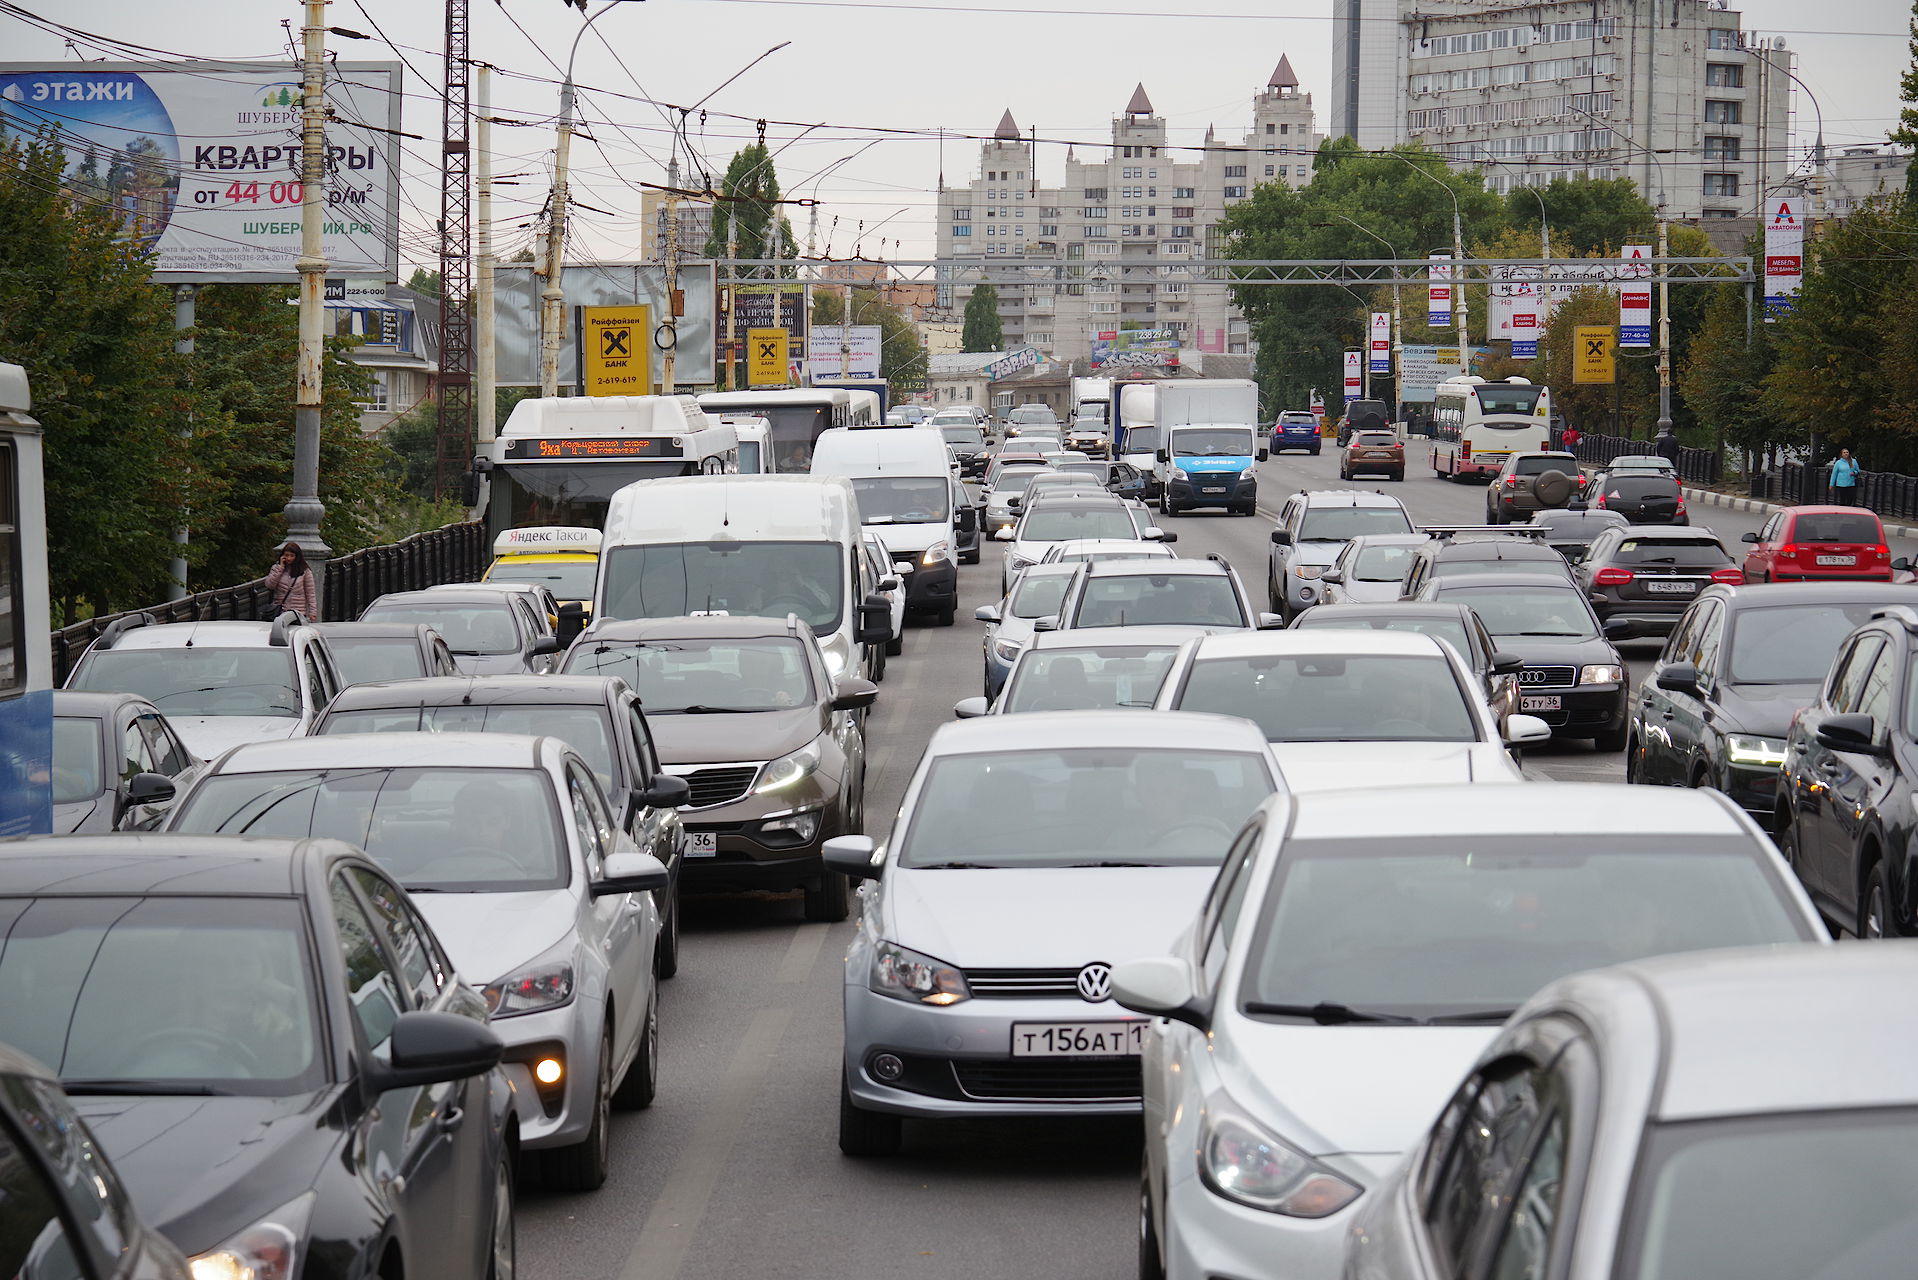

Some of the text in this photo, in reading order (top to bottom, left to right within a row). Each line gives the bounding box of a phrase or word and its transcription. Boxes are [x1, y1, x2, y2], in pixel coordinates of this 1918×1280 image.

[32, 82, 133, 101] этажи
[194, 145, 374, 170] КВАРТРЫ
[194, 190, 219, 203] от
[225, 181, 260, 203] 44
[591, 318, 640, 326] Райффайзен
[1138, 331, 1152, 339] 238
[1152, 330, 1162, 338] 29
[604, 360, 628, 368] БАНК
[597, 376, 637, 385] 2-619-619
[509, 529, 588, 542] Яндекс Такси
[1547, 697, 1558, 706] 36
[694, 834, 711, 846] 36
